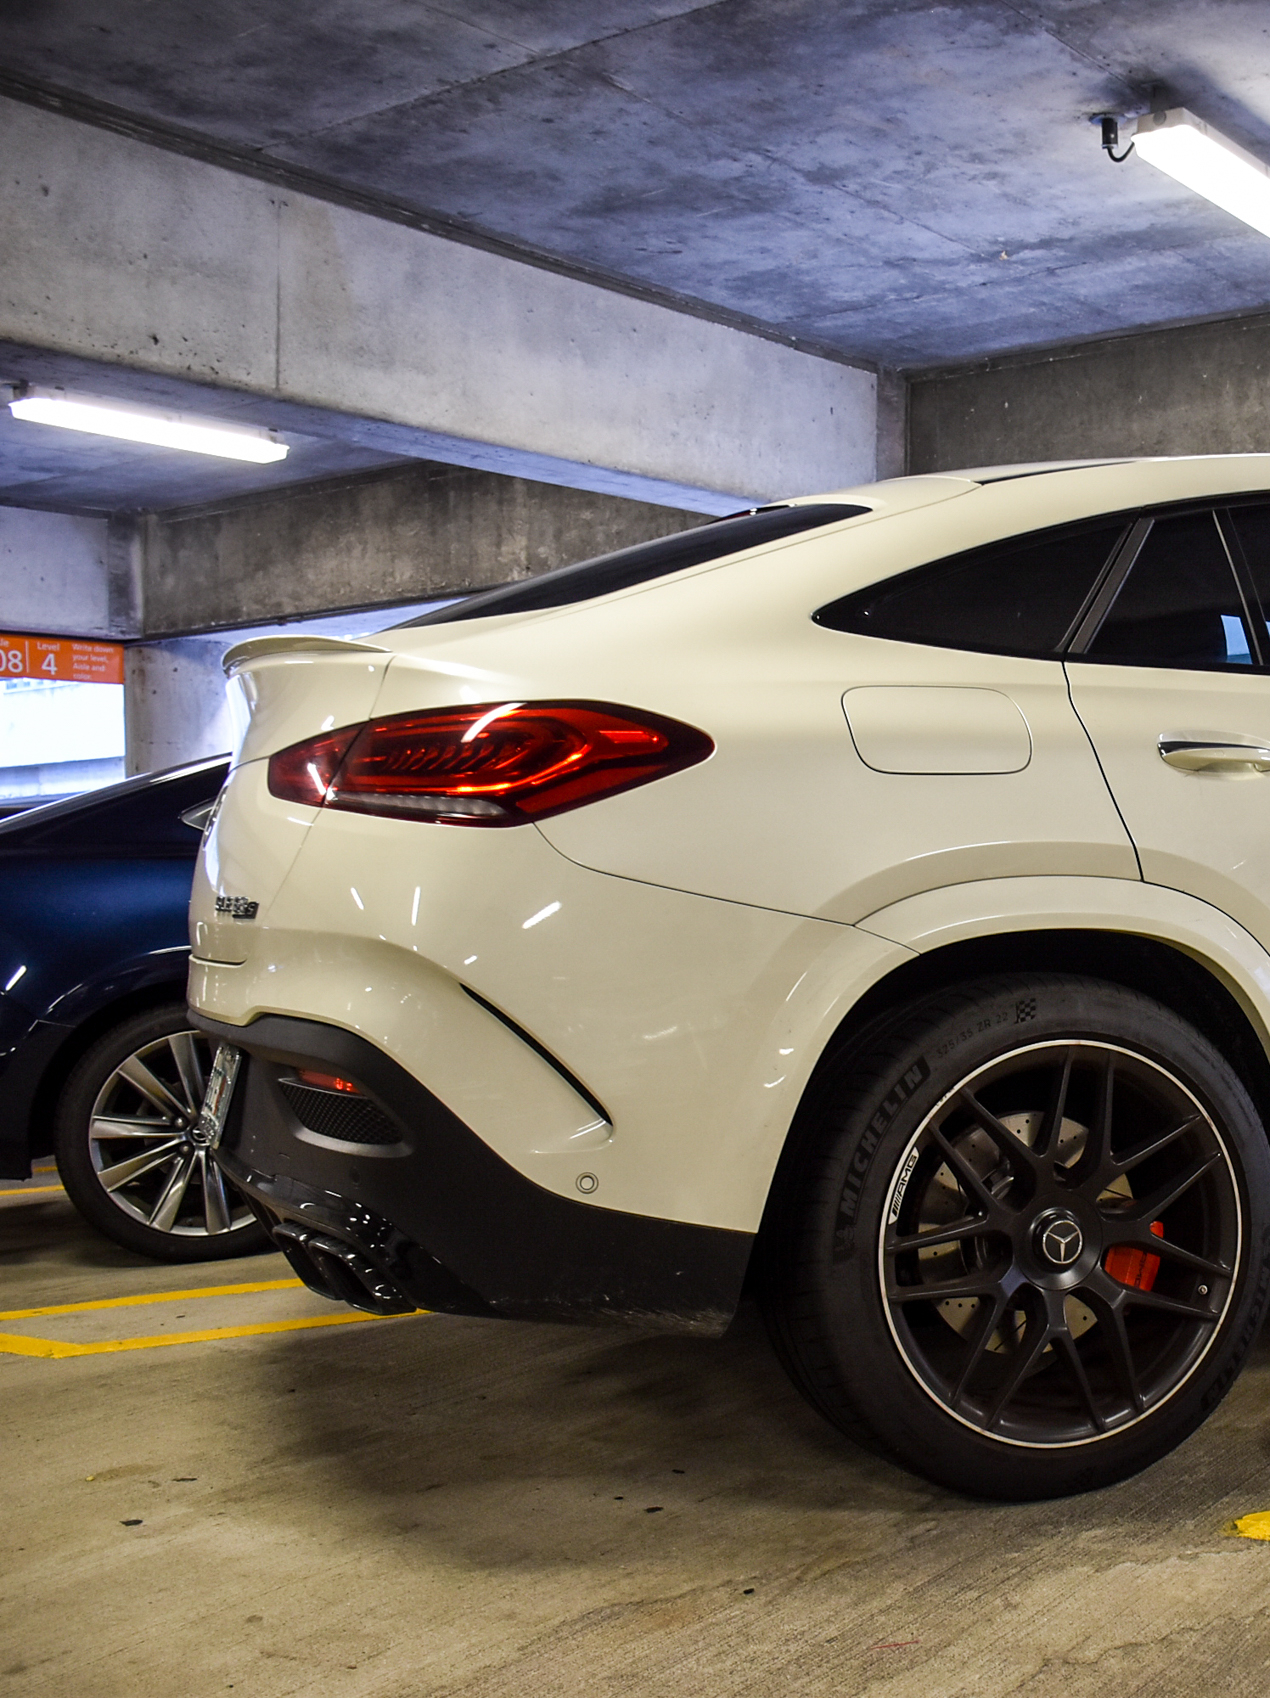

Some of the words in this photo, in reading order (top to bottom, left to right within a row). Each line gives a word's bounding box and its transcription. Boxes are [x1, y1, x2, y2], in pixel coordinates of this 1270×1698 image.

[37, 641, 60, 651] Level
[72, 643, 92, 652] Write
[94, 645, 114, 653] down
[72, 654, 89, 662] your
[41, 653, 58, 676] 4
[73, 663, 90, 671] Aisle
[91, 664, 106, 672] and
[977, 1019, 992, 1033] ZR
[839, 1064, 923, 1218] MICHELIN
[896, 1154, 918, 1198] AMG
